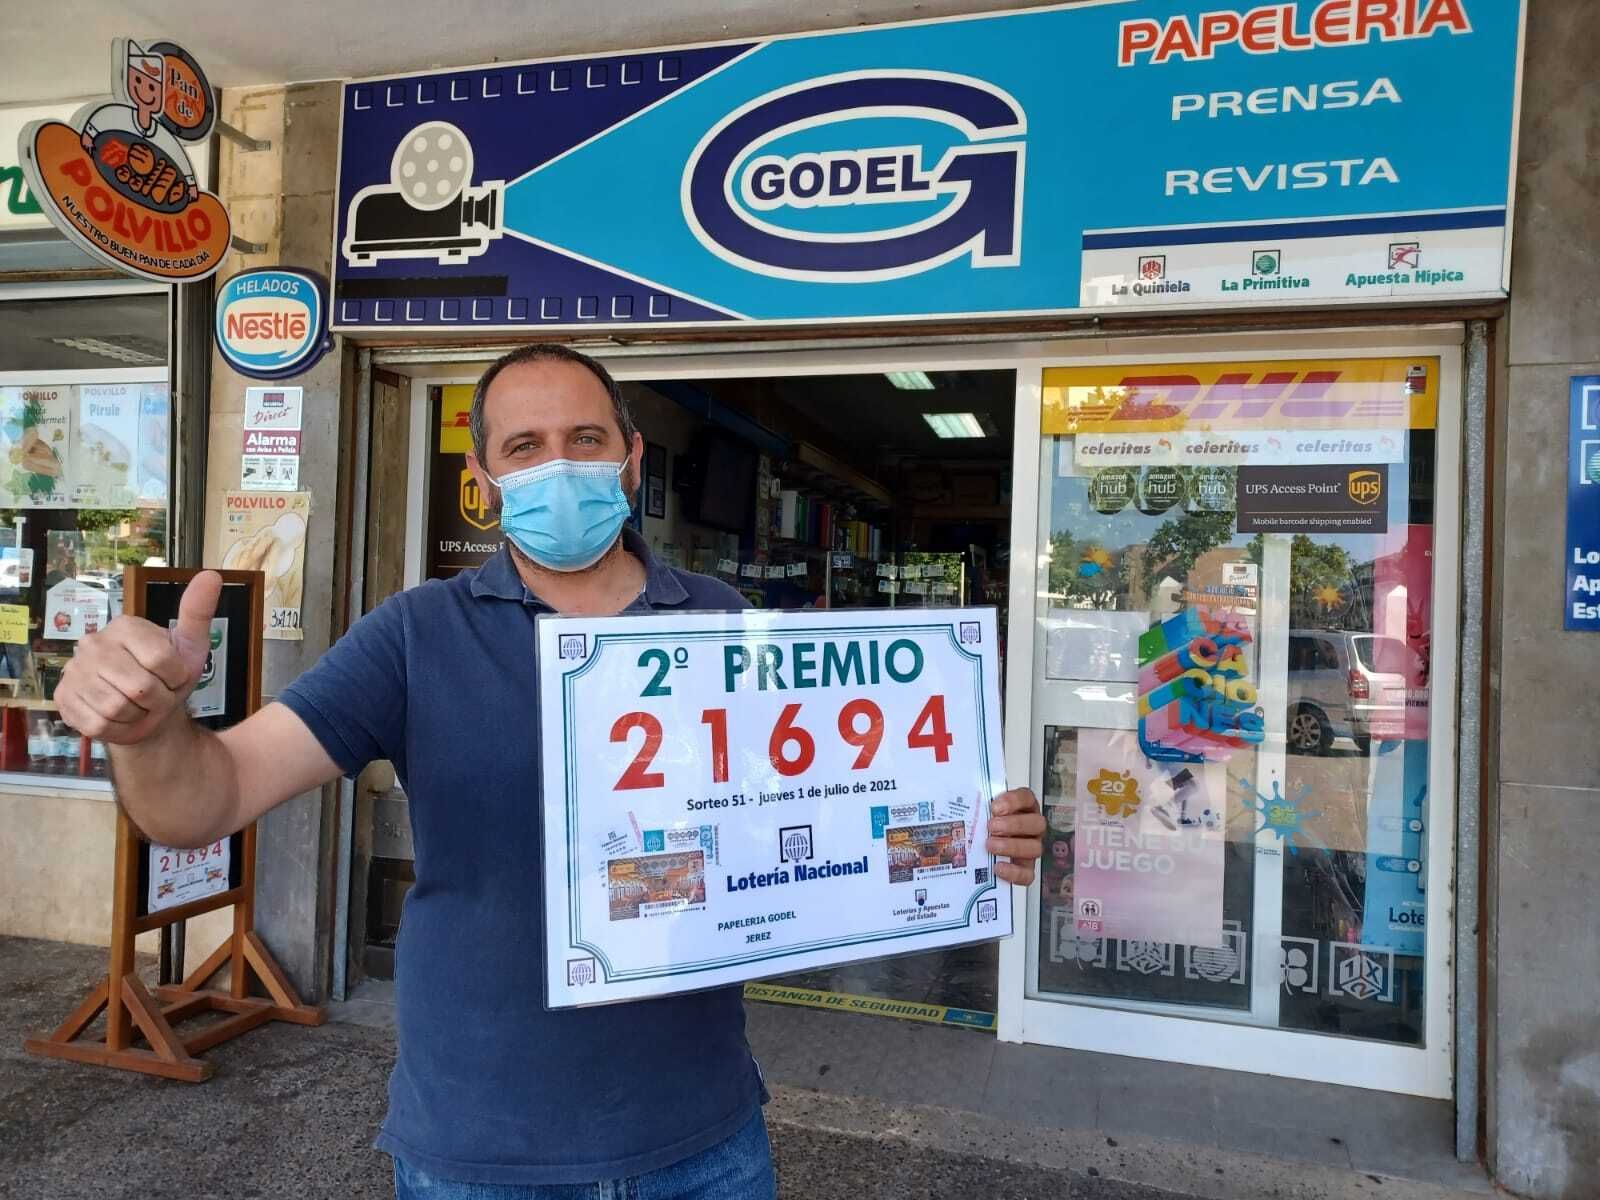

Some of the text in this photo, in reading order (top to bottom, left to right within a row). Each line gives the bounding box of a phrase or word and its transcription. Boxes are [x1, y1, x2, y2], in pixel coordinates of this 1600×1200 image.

[169, 68, 198, 99] Pan
[1171, 77, 1402, 121] PRENSA
[177, 100, 194, 120] de
[750, 153, 930, 201] GODEL
[1164, 157, 1400, 196] REVISTA
[59, 157, 212, 253] POLVILLO
[61, 195, 109, 245] NUESTRO
[110, 240, 138, 262] BUEN
[139, 254, 158, 267] PAN
[159, 258, 171, 269] DE
[172, 257, 197, 269] CADA
[236, 279, 300, 295] HELADOS
[1112, 279, 1191, 297] La Quiniela
[1221, 275, 1310, 292] La Primitiva
[1345, 271, 1410, 288] Apuesta
[1106, 370, 1354, 422] DHL
[246, 432, 297, 446] Alarma
[1081, 438, 1373, 456] celeritas celeritas celeritas
[1100, 481, 1127, 494] hub
[1149, 481, 1177, 494] hub
[1199, 481, 1227, 495] hub
[1245, 483, 1269, 495] UPS
[1270, 482, 1306, 495] Access
[1351, 481, 1379, 500] ups
[227, 496, 286, 509] POLVILLO
[1252, 516, 1372, 527] Mobile barcode shipping enabled
[440, 541, 461, 553] UPS
[463, 542, 497, 553] Access
[723, 638, 924, 693] PREMIO
[1101, 780, 1125, 792] 20
[687, 799, 729, 812] Sorteo
[732, 794, 746, 807] 51
[759, 790, 795, 806] jueves
[798, 788, 804, 799] 1
[807, 786, 821, 799] de
[824, 783, 849, 800] julio
[852, 781, 867, 794] de
[870, 780, 897, 792] 2021
[1081, 826, 1162, 850] TIENE
[1080, 849, 1176, 875] JUEGO
[726, 855, 869, 893] Lotería Nacional
[717, 910, 797, 932] PAPELERIA GODEL
[745, 931, 771, 944] JEREZ
[744, 986, 940, 1019] DISTANCIA DE SEGURIDAD
